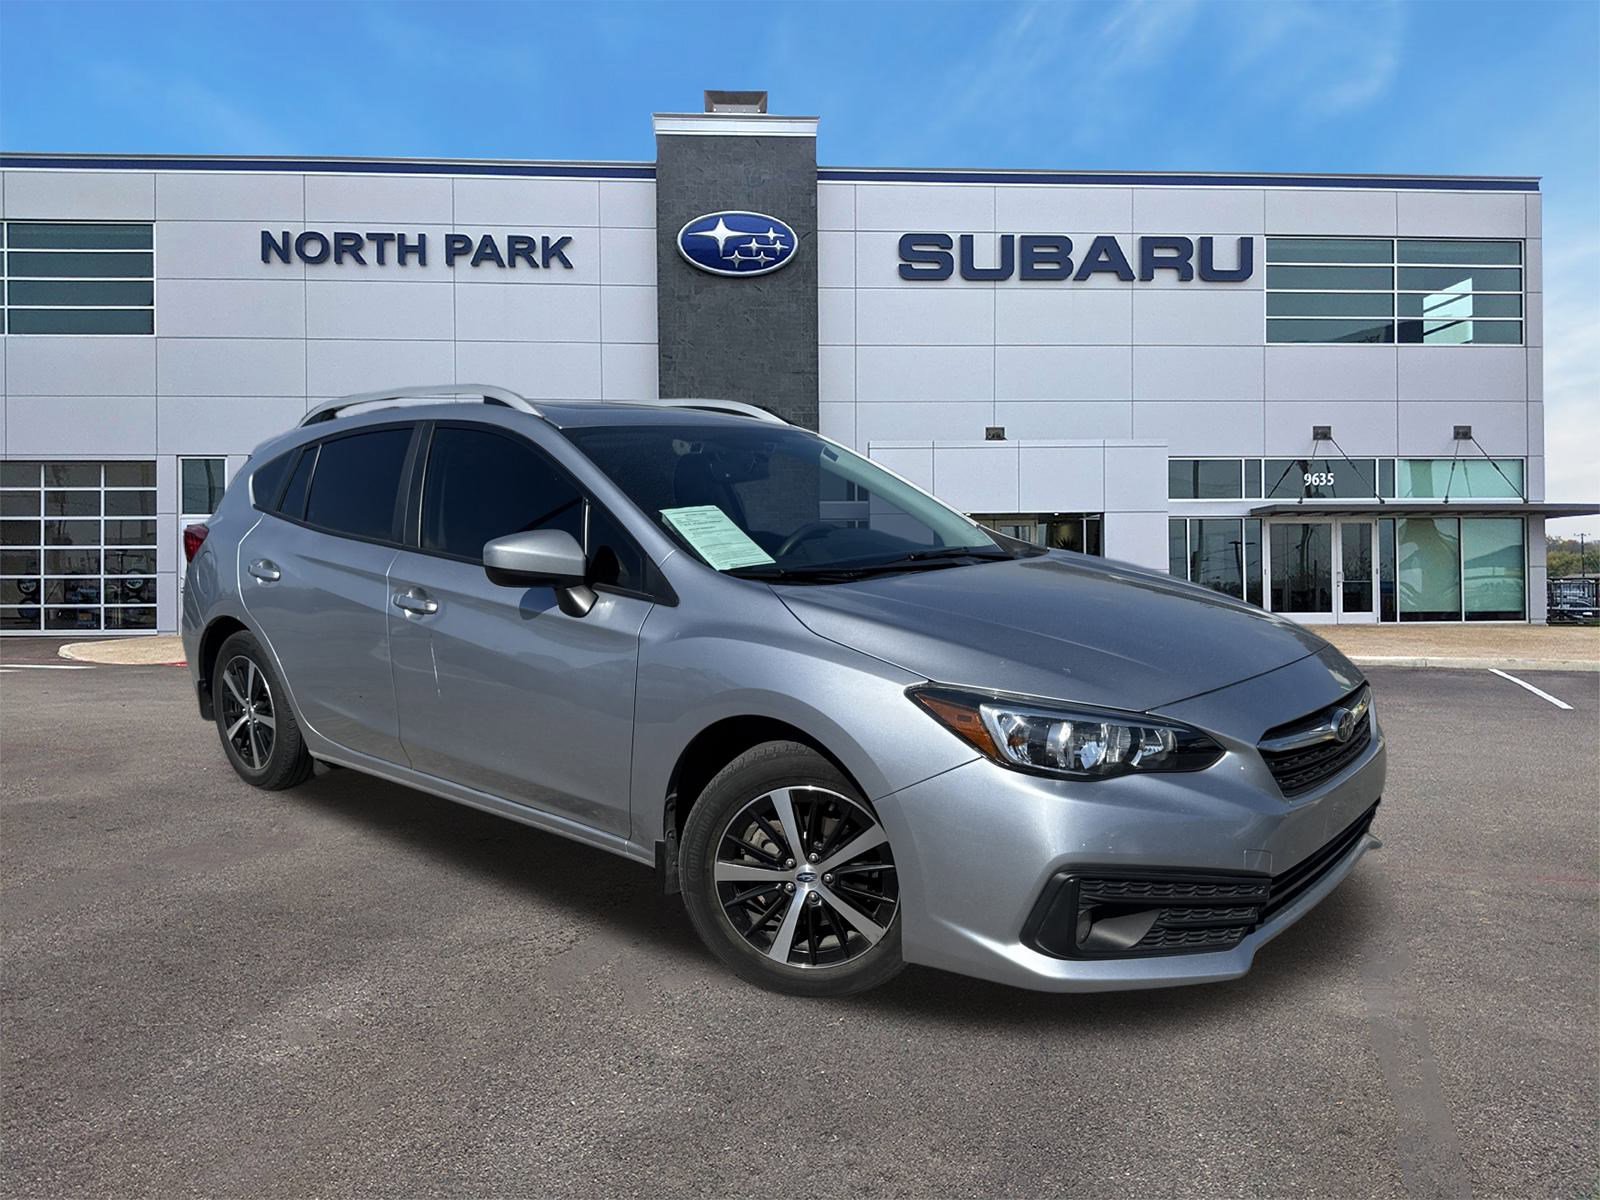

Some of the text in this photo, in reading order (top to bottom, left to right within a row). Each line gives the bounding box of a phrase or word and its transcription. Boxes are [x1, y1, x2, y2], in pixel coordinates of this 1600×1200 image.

[261, 230, 574, 269] NORTH PARK
[898, 232, 1254, 283] SUBARU
[1303, 472, 1335, 486] 9635
